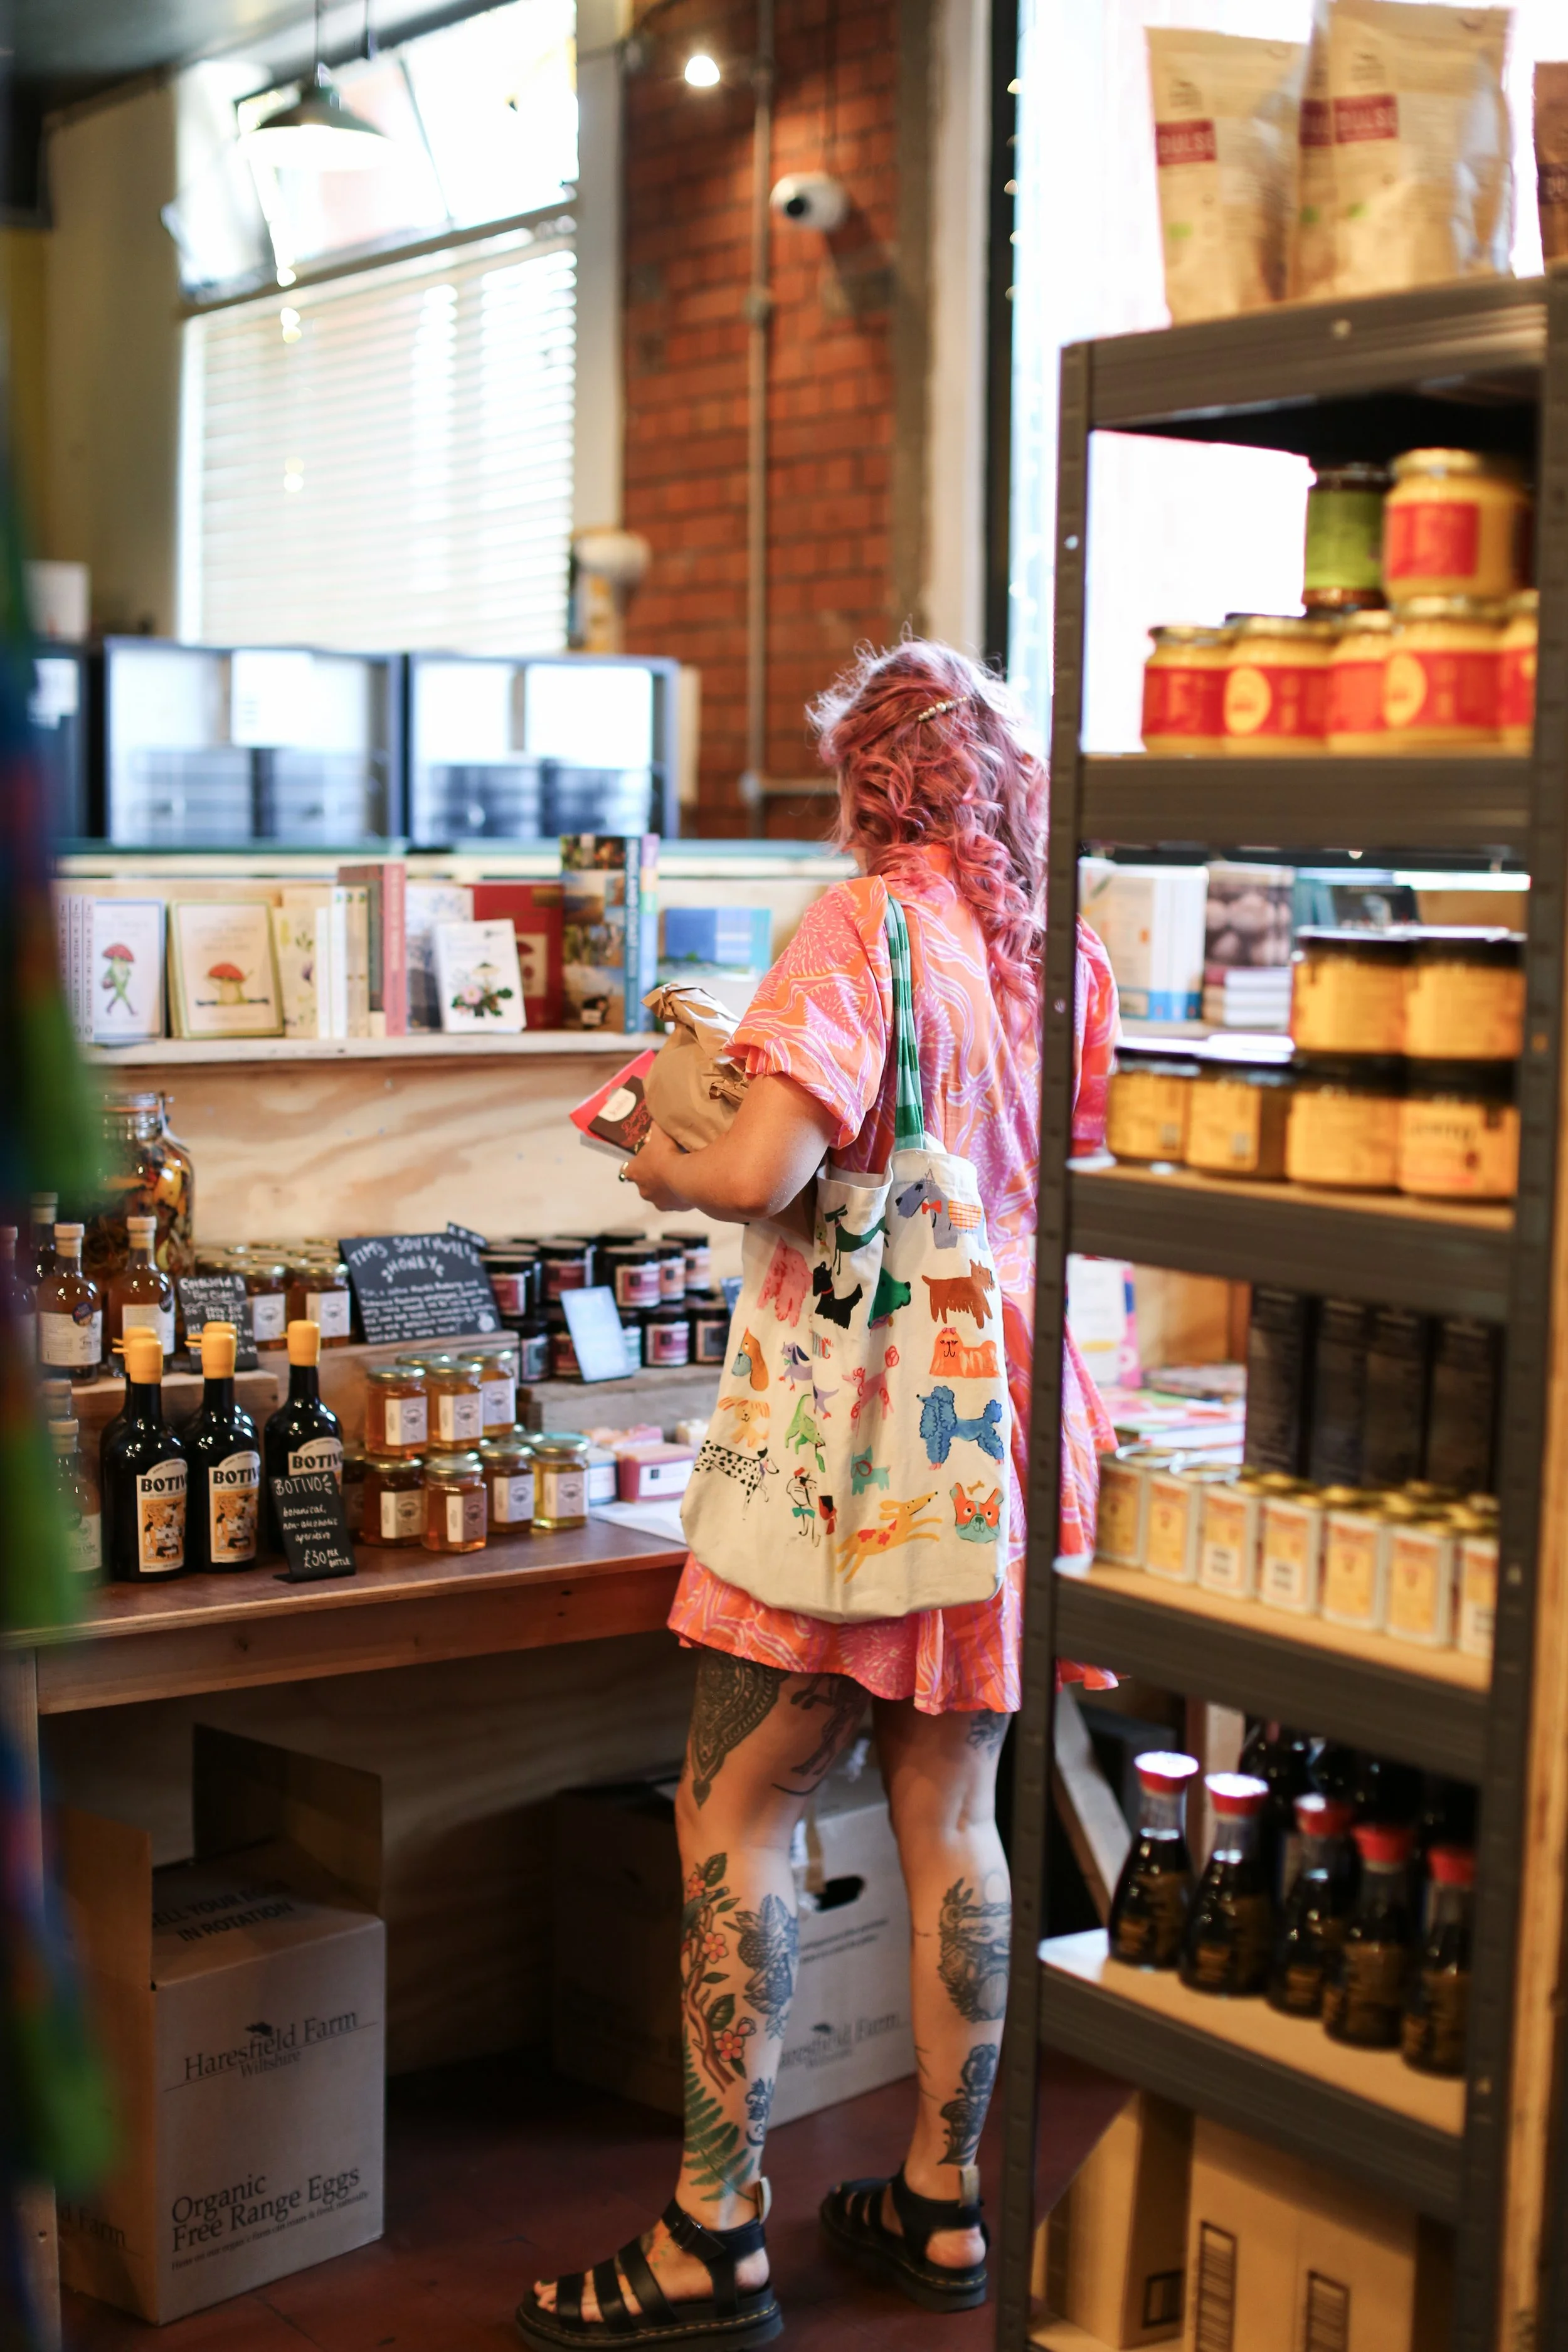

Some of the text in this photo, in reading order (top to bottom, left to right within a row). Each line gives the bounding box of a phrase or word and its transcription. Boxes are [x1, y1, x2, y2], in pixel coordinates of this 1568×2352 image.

[386, 1255, 438, 1275] HONEY
[140, 1475, 186, 1493] BOTIV
[213, 1468, 257, 1485] BOTIV
[273, 1475, 322, 1496] BOTIVO
[304, 1549, 327, 1568] £30
[185, 1893, 242, 1917] YOUR
[176, 1901, 294, 1942] IN ROTATION
[184, 2011, 359, 2081] Haresfield Farm
[240, 2050, 302, 2078] Wiltshire
[171, 2173, 267, 2224] Organic
[172, 2166, 361, 2253] Free Range Eggs
